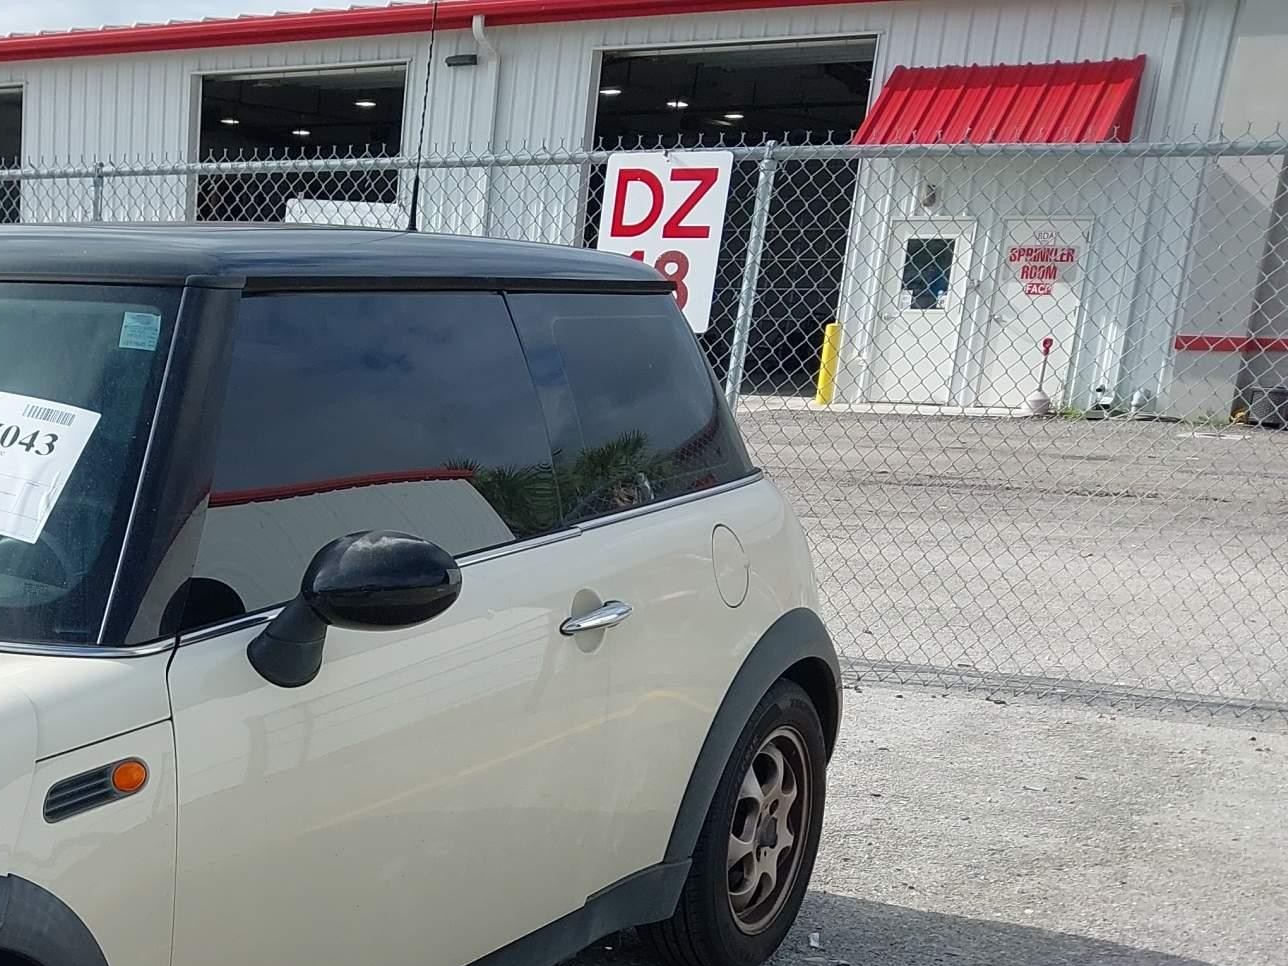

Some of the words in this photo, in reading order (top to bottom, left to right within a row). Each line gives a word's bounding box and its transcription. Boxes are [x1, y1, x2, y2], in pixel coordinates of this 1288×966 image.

[611, 168, 719, 239] DZ
[1009, 247, 1075, 262] SPRINKLER
[1020, 265, 1057, 280] ROOM
